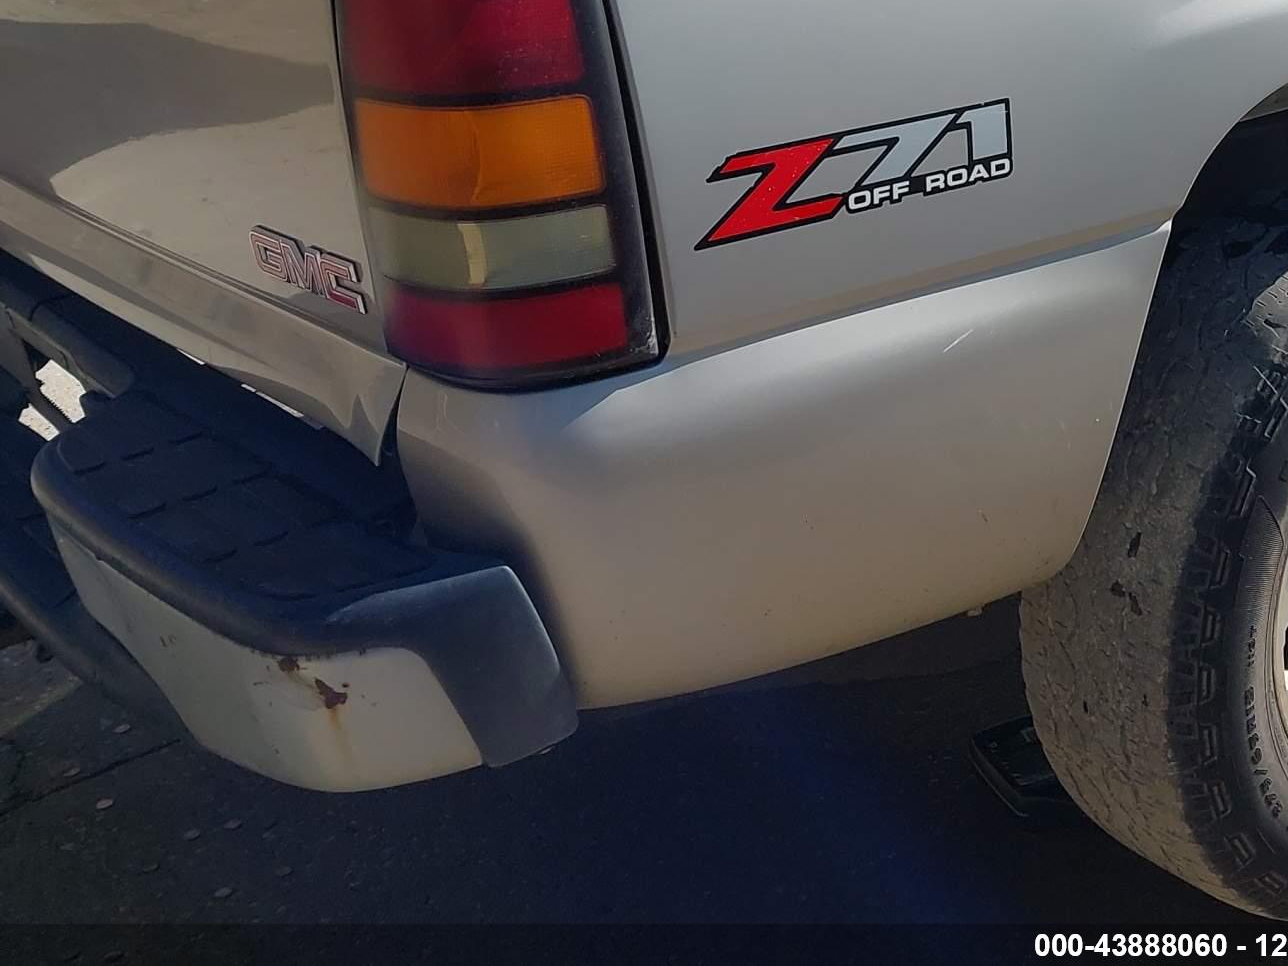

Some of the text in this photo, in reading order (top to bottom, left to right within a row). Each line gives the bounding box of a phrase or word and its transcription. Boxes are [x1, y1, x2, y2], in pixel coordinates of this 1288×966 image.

[693, 97, 1013, 251] Z71
[848, 159, 1011, 211] OFF ROAD
[249, 225, 367, 314] GMC
